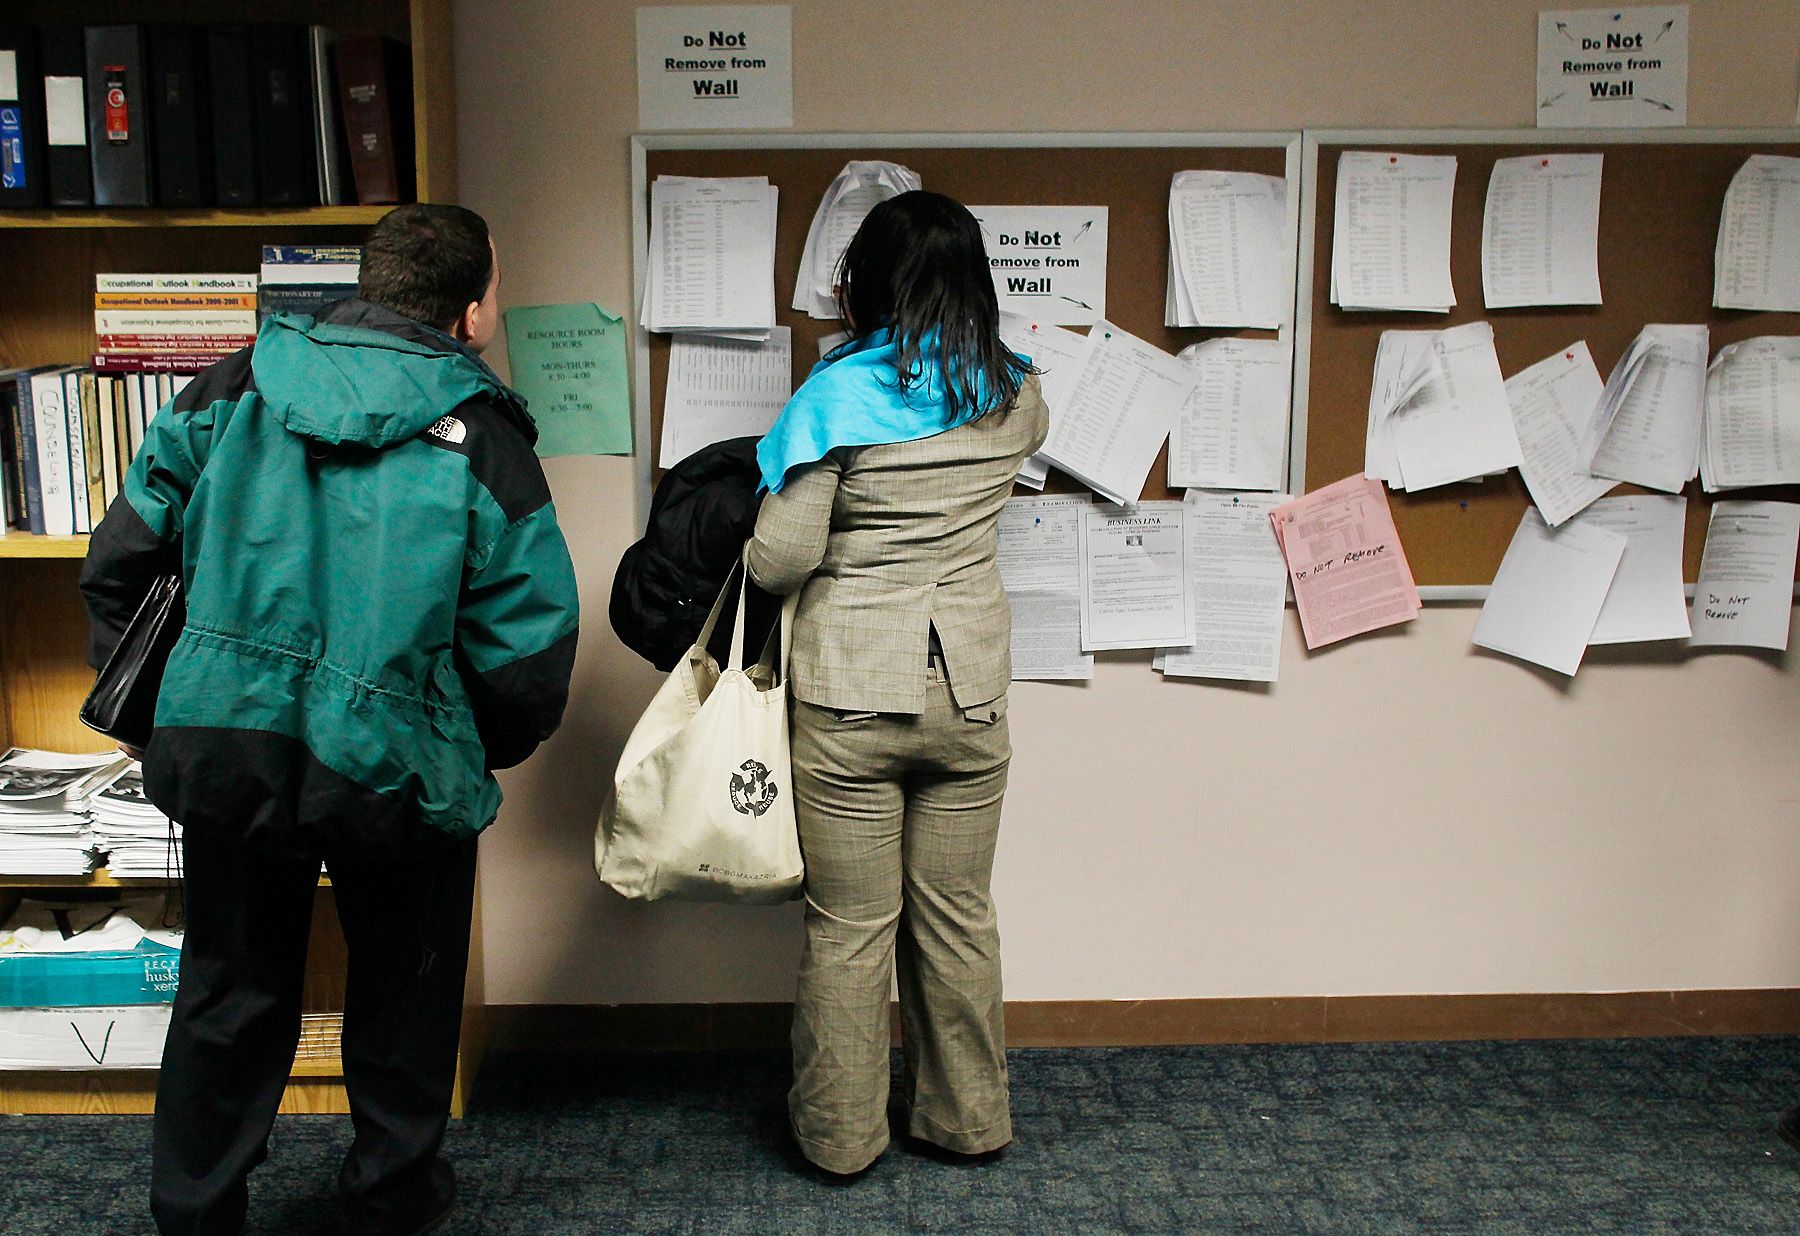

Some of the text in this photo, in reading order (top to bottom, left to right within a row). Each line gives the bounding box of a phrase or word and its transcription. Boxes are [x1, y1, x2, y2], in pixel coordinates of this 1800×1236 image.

[683, 31, 746, 47] Do Not
[1582, 33, 1643, 50] Do Not
[665, 57, 766, 69] Remove from
[1562, 58, 1661, 72] Remove from
[693, 79, 738, 95] Wall
[1590, 80, 1634, 97] Wall
[1000, 230, 1062, 246] Do Not
[988, 256, 1080, 267] emove from
[101, 279, 154, 288] Occupational
[156, 279, 189, 288] Outlook
[192, 279, 236, 288] Handbook
[1007, 277, 1052, 293] Wall
[101, 297, 142, 306] Occupational
[144, 297, 169, 305] Outlook
[171, 297, 203, 305] Handbook
[155, 318, 195, 327] Occupational
[527, 328, 605, 340] RESOURCE ROOM
[551, 341, 583, 349] HOURS
[1107, 518, 1142, 527] BUSINESS
[1313, 559, 1334, 574] NOT
[144, 960, 180, 969] RECY
